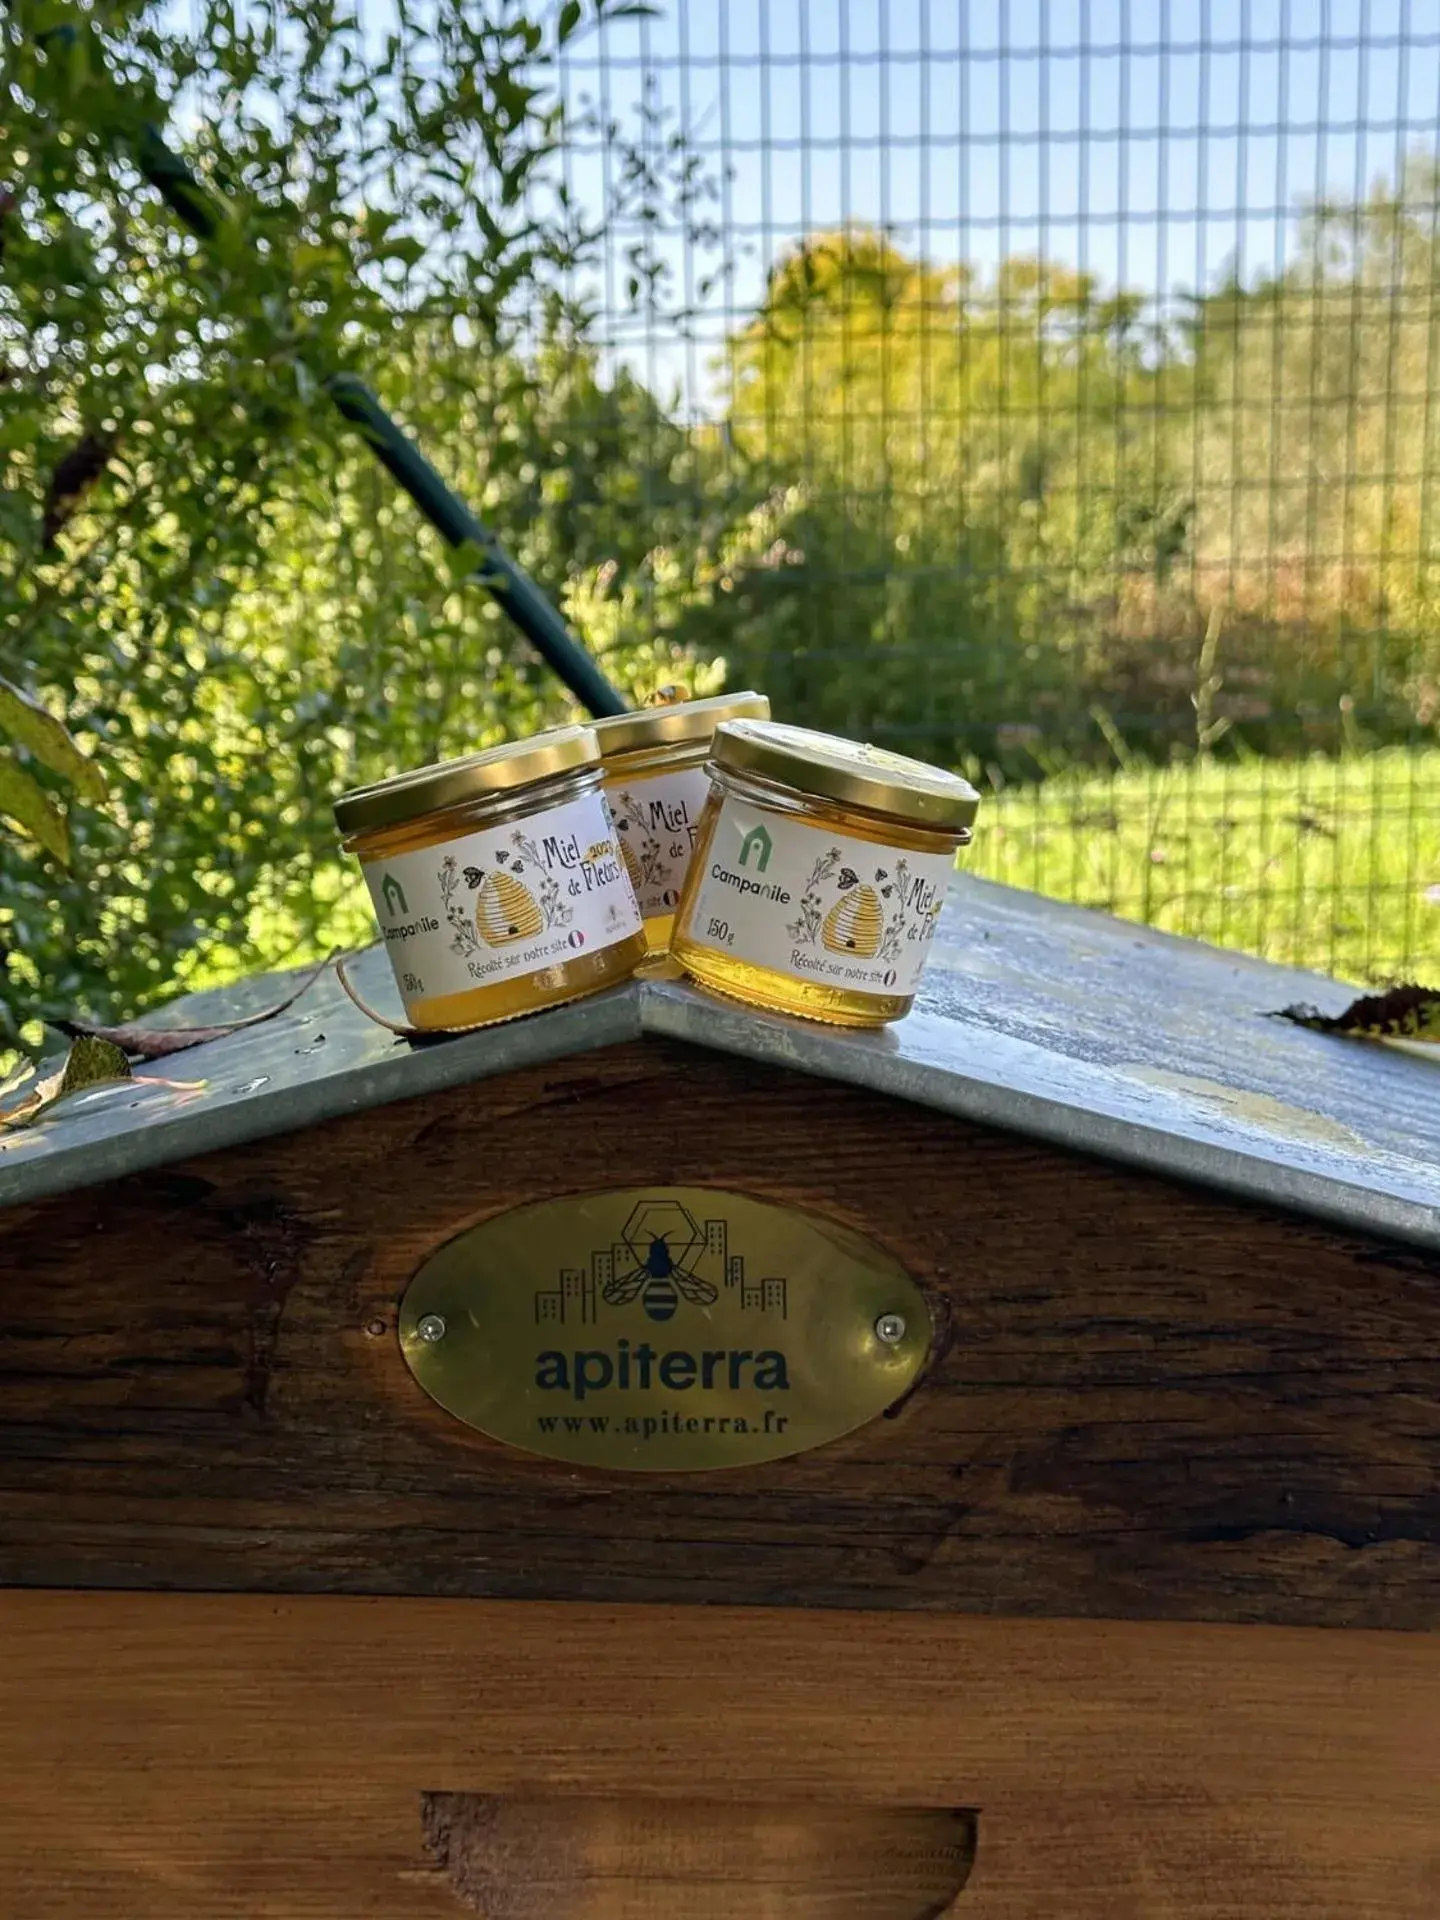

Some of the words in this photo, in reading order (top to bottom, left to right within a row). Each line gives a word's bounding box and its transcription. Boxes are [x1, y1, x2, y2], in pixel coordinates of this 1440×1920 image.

[649, 800, 688, 832] Miel
[543, 834, 580, 869] Miel
[669, 841, 684, 858] de
[568, 879, 582, 896] de
[580, 860, 619, 891] Fleurs
[712, 864, 791, 904] Campanile
[907, 878, 936, 915] Miel
[467, 961, 503, 979] Récolté
[506, 953, 521, 969] sur
[523, 946, 549, 962] notre
[550, 939, 568, 954] site
[789, 949, 826, 972] Récolté
[826, 962, 844, 976] sur
[845, 967, 869, 981] notre
[535, 1339, 790, 1401] apiterra
[536, 1410, 789, 1440] www.apiterra.fr
